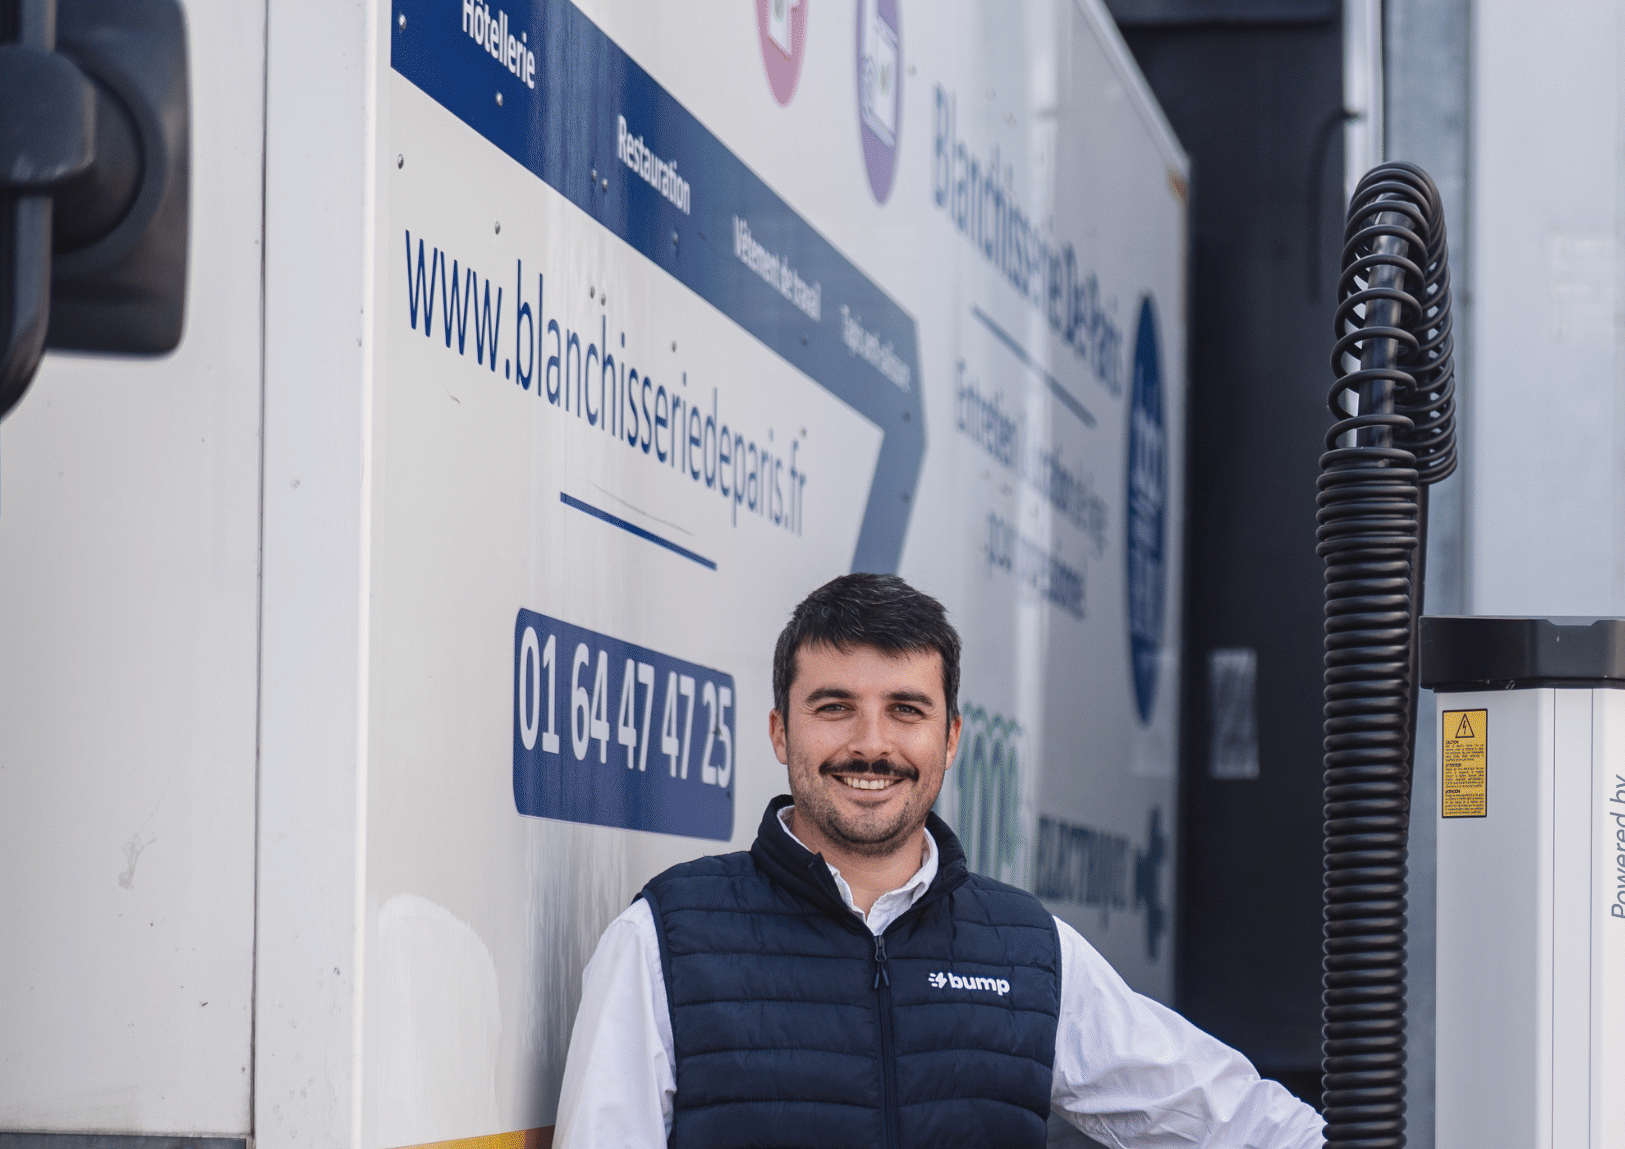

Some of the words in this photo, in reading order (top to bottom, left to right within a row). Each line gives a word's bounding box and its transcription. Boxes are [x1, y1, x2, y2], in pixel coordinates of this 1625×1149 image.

[616, 114, 691, 216] Restauration
[405, 229, 807, 538] www.blanchisseriedeparis.fr
[519, 626, 560, 755] 01
[571, 642, 611, 765] 64
[618, 658, 655, 772] 47
[661, 670, 696, 780] 47
[702, 680, 733, 788] 25
[947, 972, 1011, 996] bump
